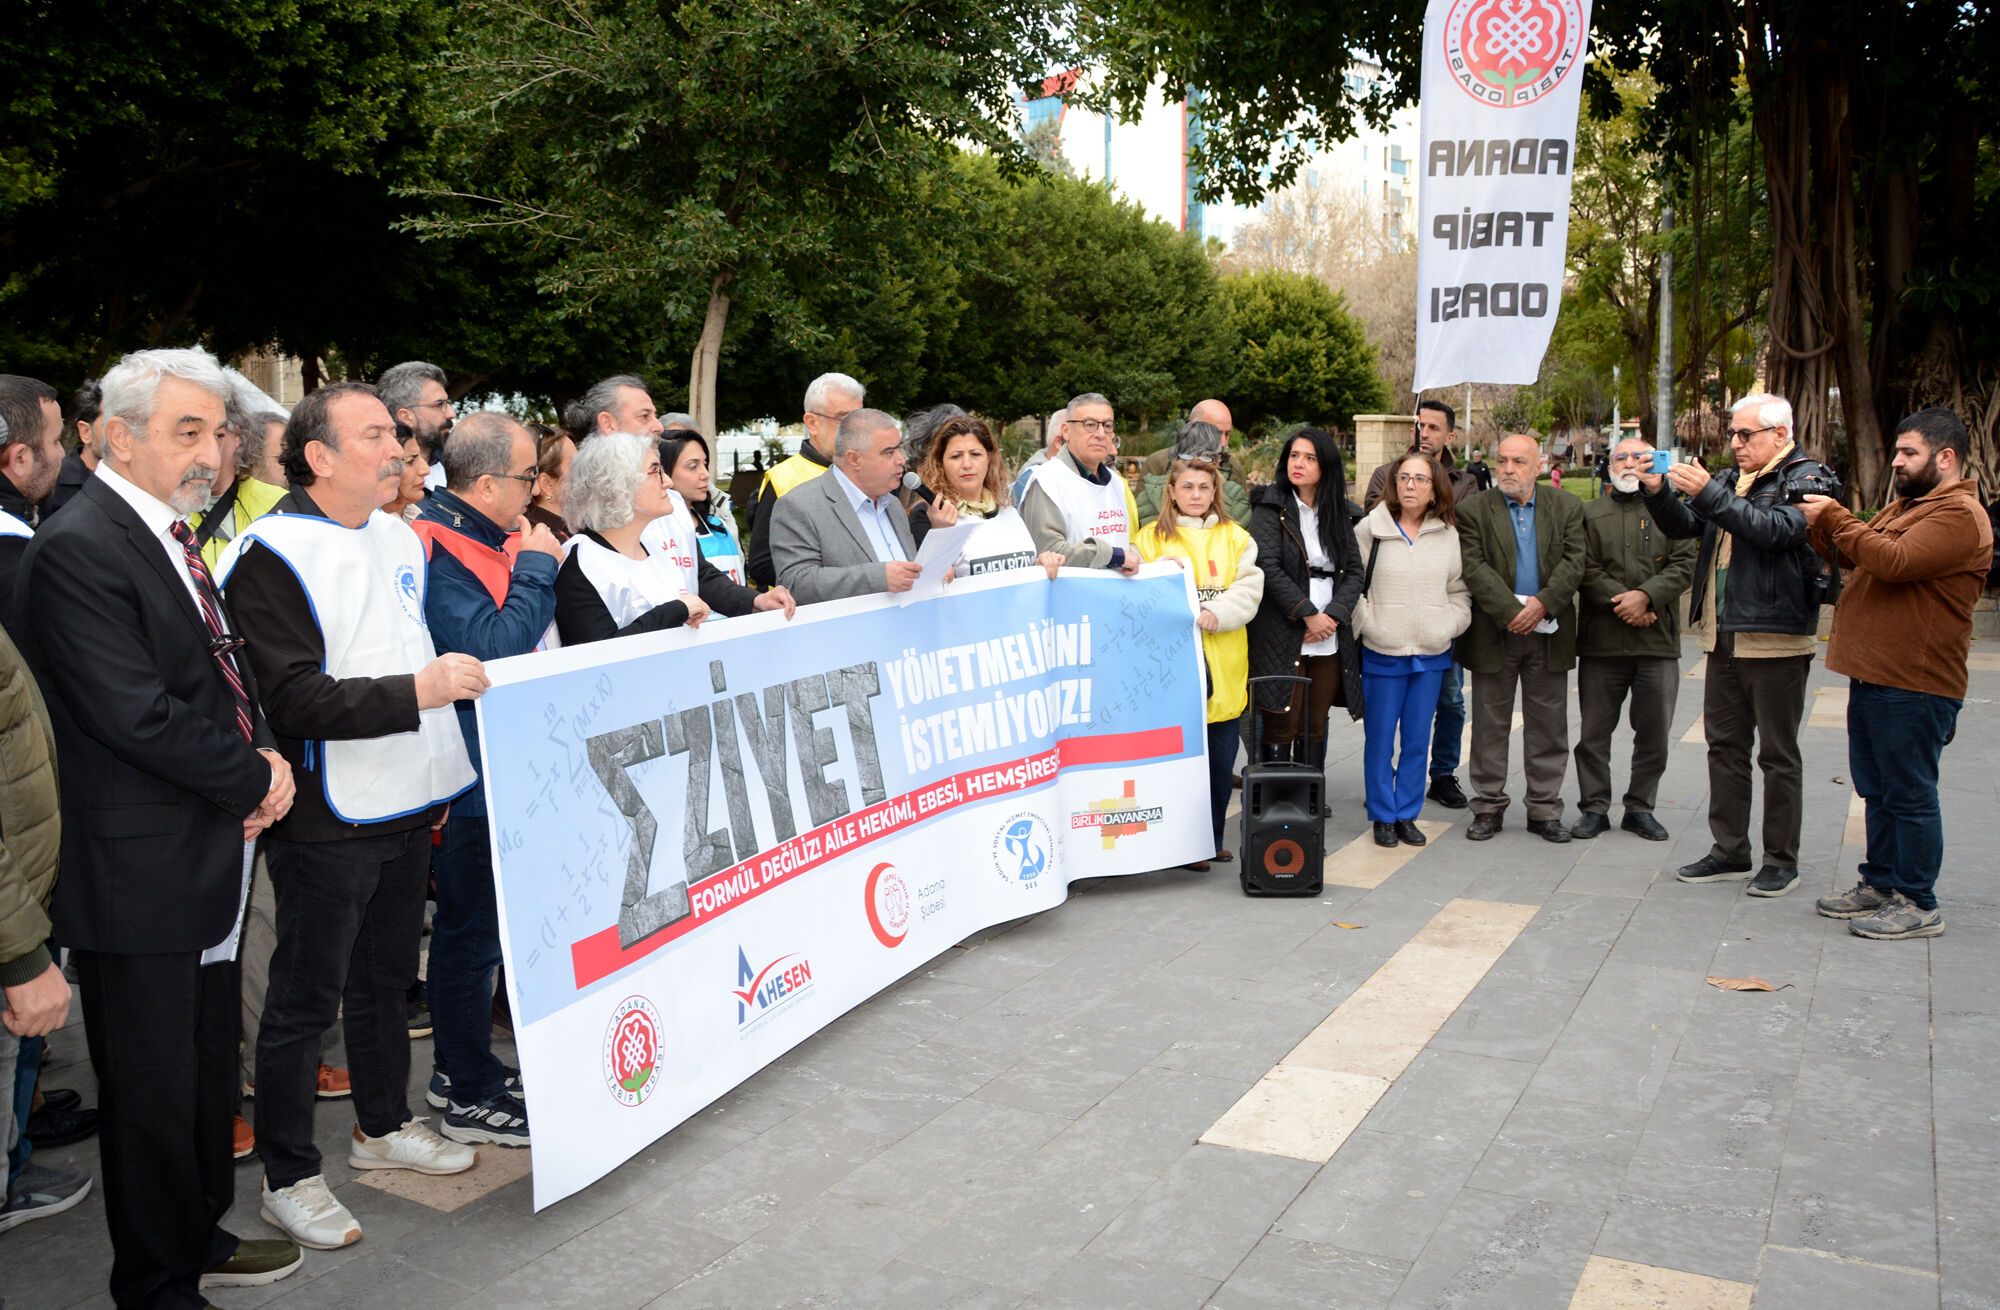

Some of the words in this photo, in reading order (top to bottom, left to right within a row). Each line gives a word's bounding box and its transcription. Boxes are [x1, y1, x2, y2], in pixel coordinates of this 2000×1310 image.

[691, 864, 760, 919] FORMÜL
[760, 836, 823, 884] DEĞİLİZ!
[825, 822, 858, 854] AİLE
[858, 792, 917, 838] HEKİMİ,
[918, 776, 964, 814] EBESİ,
[1025, 880, 1038, 890] SES
[615, 1000, 646, 1023] ADANA
[645, 1045, 663, 1094] ODASI
